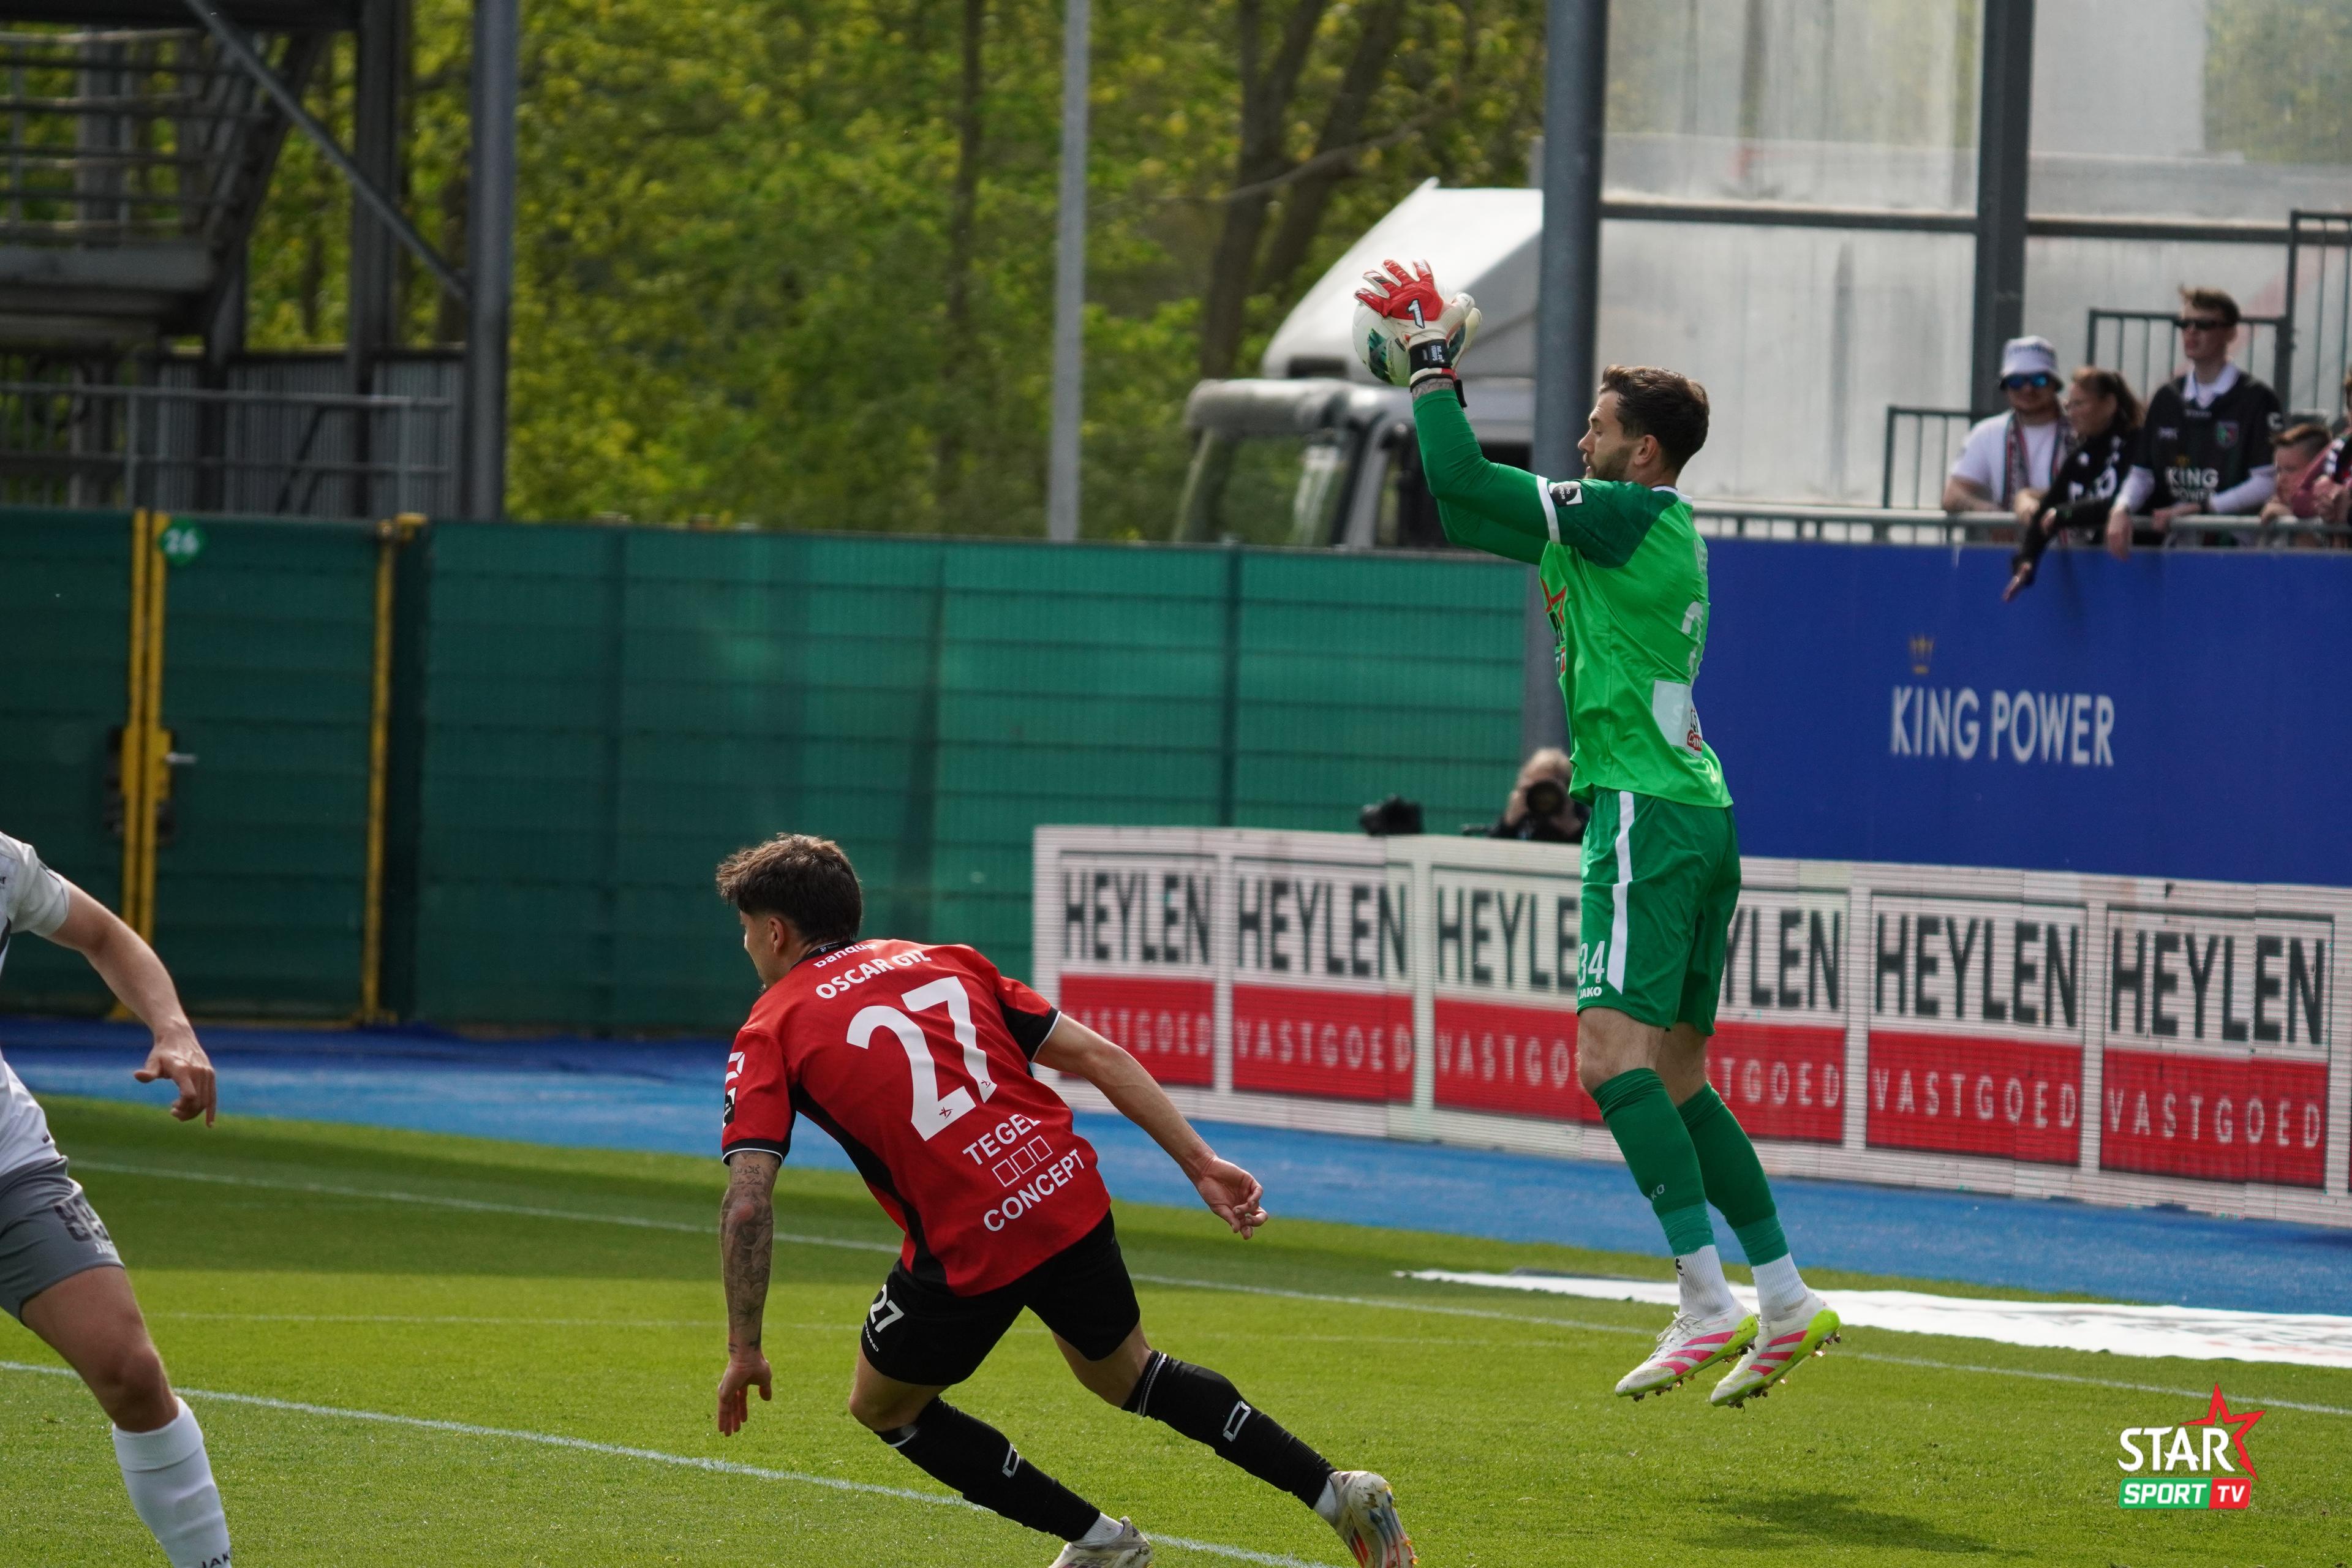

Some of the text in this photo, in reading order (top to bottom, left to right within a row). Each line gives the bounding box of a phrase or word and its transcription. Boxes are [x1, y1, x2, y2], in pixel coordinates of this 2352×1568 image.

[2165, 467, 2219, 488] KING
[1891, 685, 2115, 767] KING POWER
[1065, 871, 1211, 963] HEYLEN
[1238, 878, 1407, 977] HEYLEN
[1436, 885, 1580, 992] HEYLE
[816, 950, 932, 999] OSCAR GIL
[1578, 940, 1605, 986] 34
[1725, 905, 1842, 1011] YLEN
[1875, 911, 2078, 1028] HEYLEN
[2111, 927, 2324, 1045] HEYLEN
[1579, 986, 1602, 1000] JAKO
[846, 976, 998, 1142] 27
[1066, 1008, 1212, 1057] ASTGOED
[1235, 1019, 1413, 1072] VASTGOED
[1436, 1033, 1570, 1089] VASTGO
[1719, 1057, 1840, 1107] TGOED
[1872, 1068, 2076, 1128] VASTGOED
[962, 1114, 1041, 1166] TEGEL
[2108, 1087, 2321, 1148] VASTGOED
[984, 1148, 1085, 1232] CONCEPT
[870, 1284, 905, 1333] 27
[202, 1551, 230, 1568] JAK
